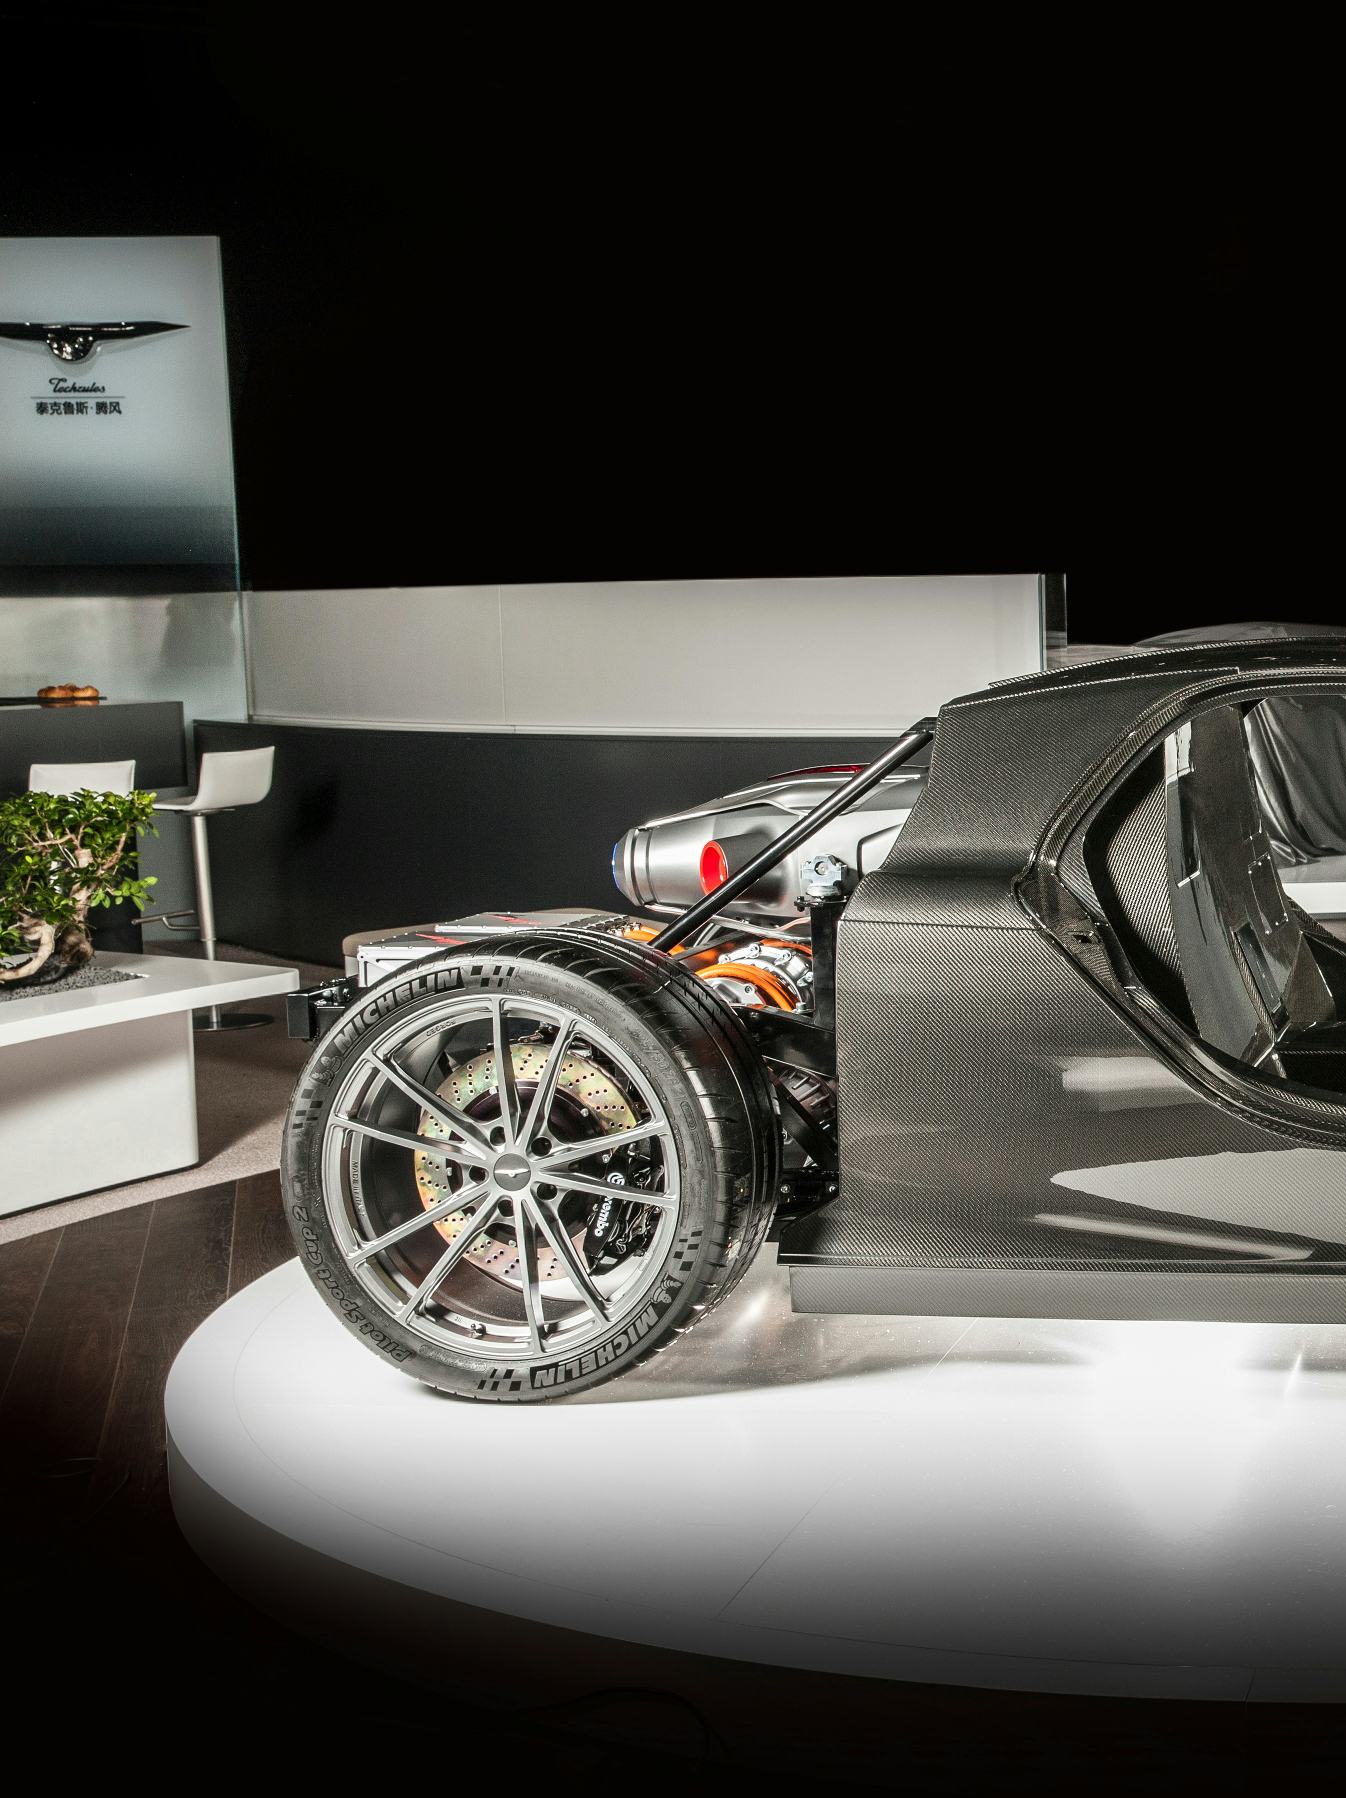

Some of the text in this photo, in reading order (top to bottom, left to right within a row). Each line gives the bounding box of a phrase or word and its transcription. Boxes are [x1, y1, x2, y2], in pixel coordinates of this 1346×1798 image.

[48, 377, 106, 394] Techrules
[333, 968, 460, 1054] MICHELIN
[594, 1196, 613, 1237] rembo
[292, 1205, 413, 1363] Pilot Sport Cup 2
[533, 1306, 660, 1389] MICHELIN
